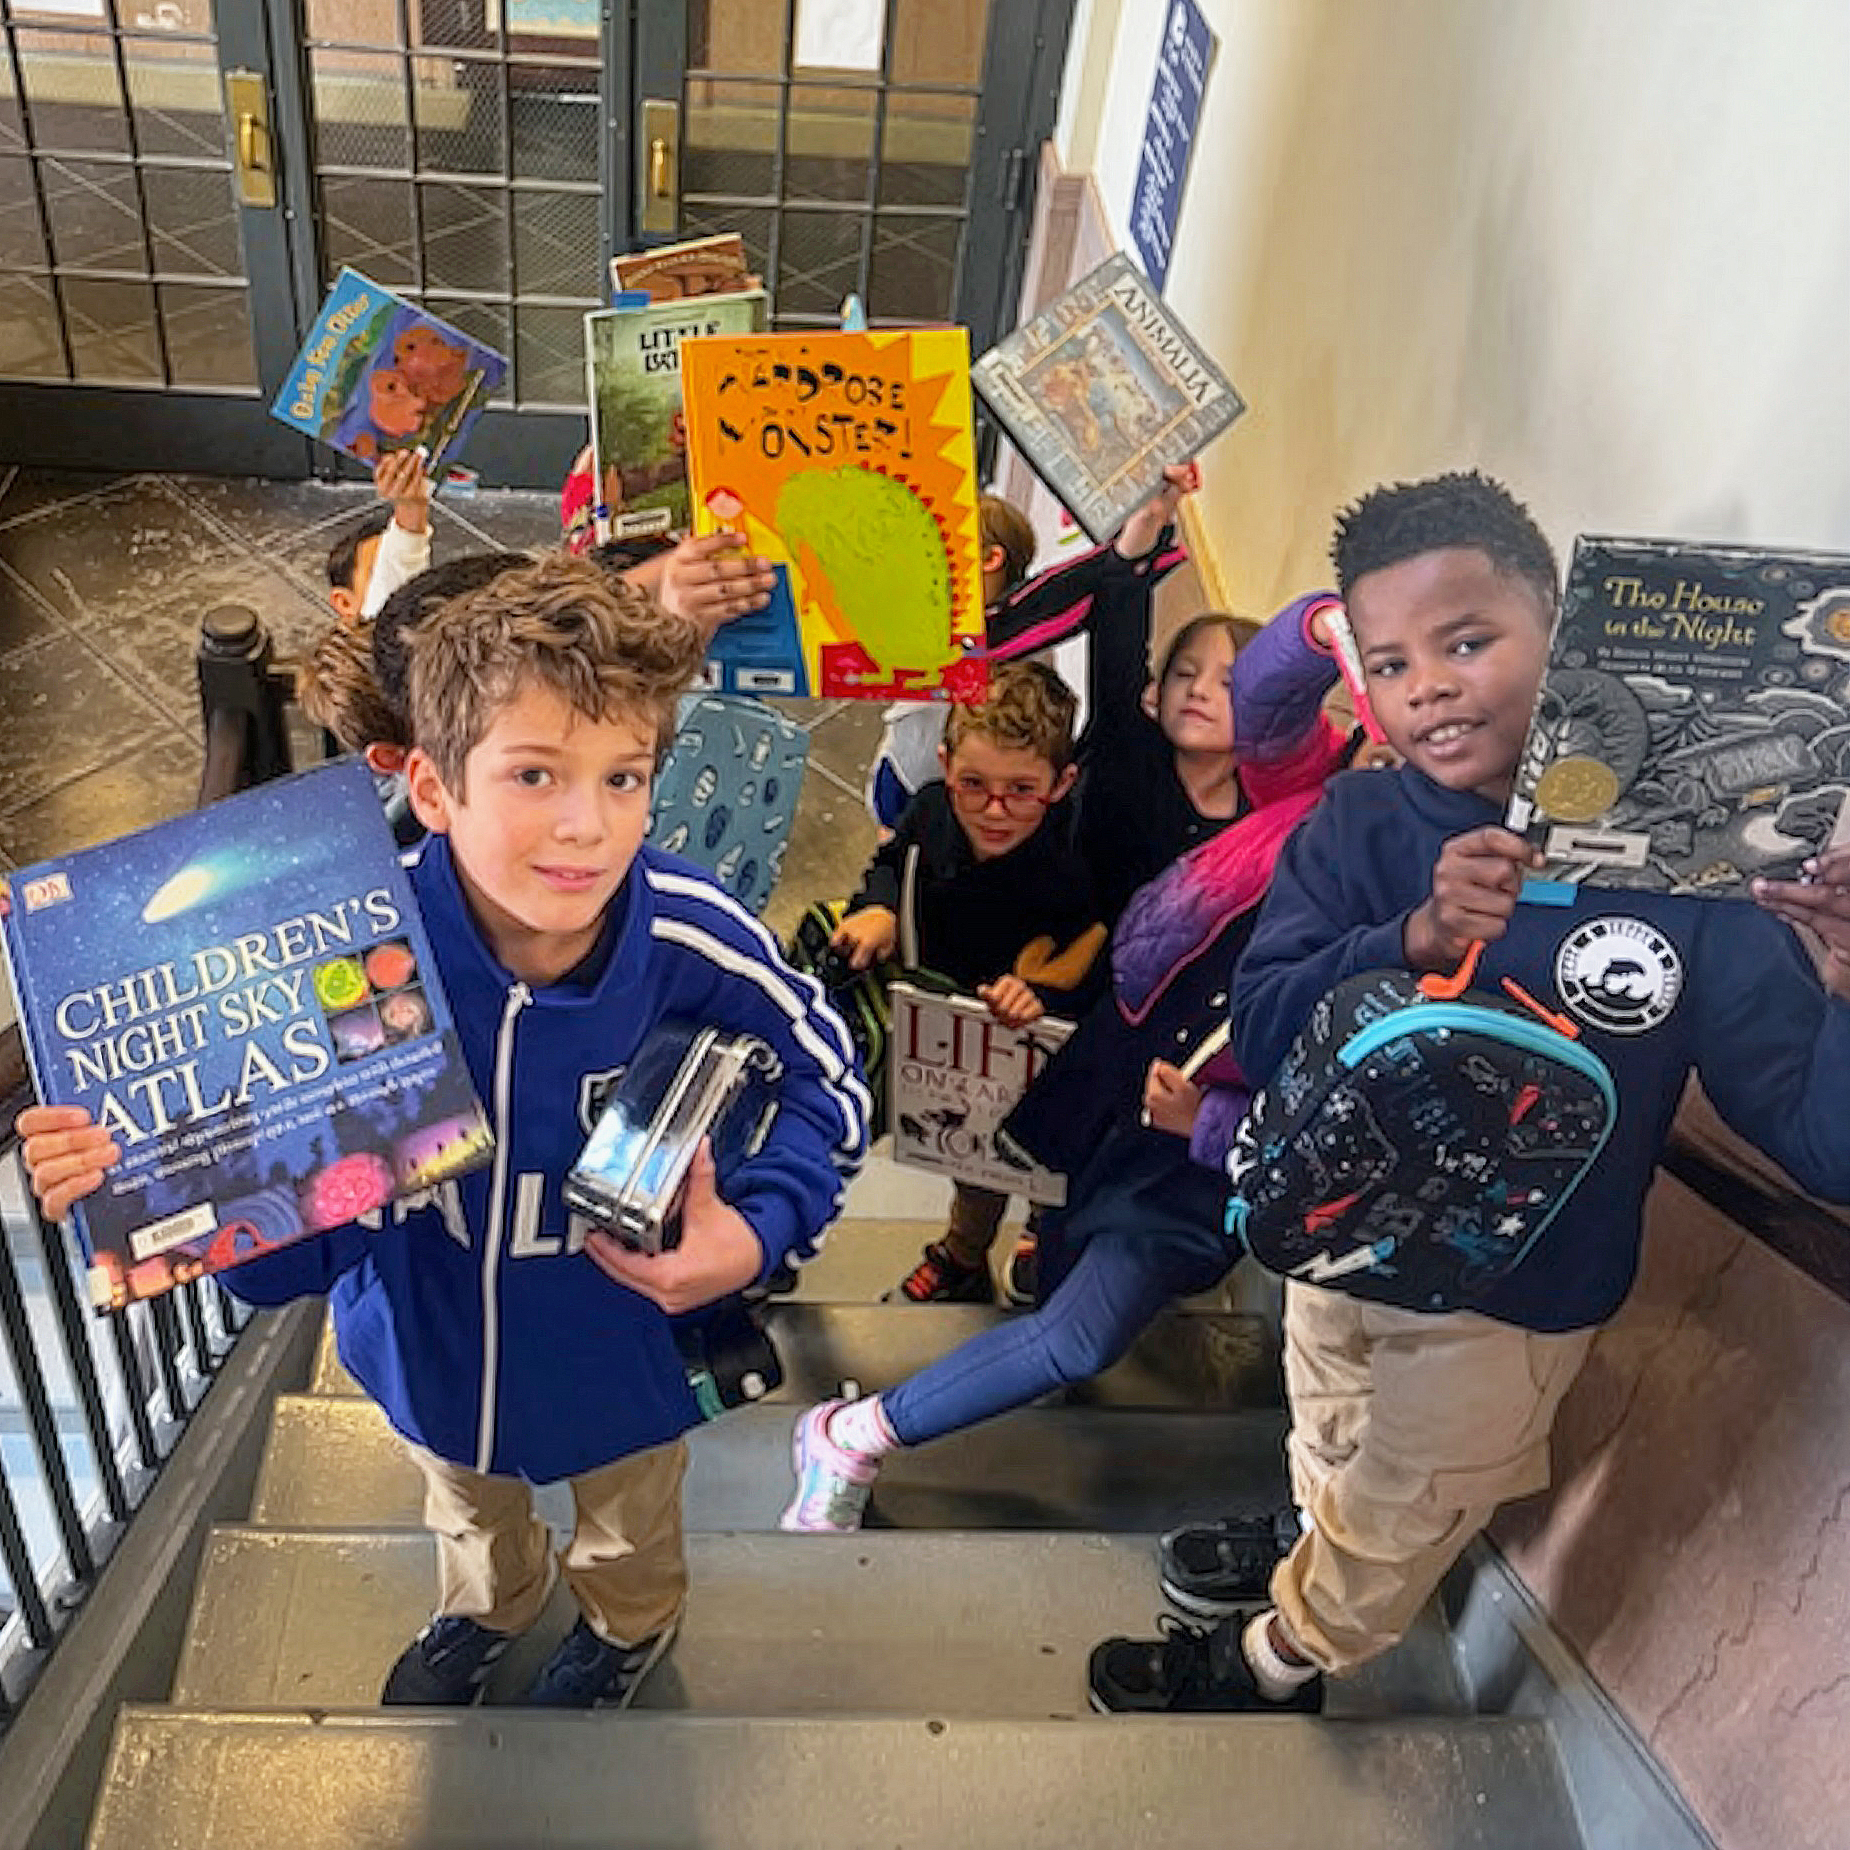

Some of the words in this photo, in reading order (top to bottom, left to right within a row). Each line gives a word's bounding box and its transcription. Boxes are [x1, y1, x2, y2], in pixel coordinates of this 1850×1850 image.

[1602, 575, 1668, 609] The
[1671, 578, 1766, 615] House
[1604, 619, 1628, 636] in
[1632, 615, 1666, 638] the
[1661, 612, 1757, 650] Night
[54, 888, 401, 1040] CHILDREN'S
[65, 1003, 210, 1094] NIGHT
[217, 968, 306, 1038] SKY
[100, 1016, 330, 1146] ATLAS
